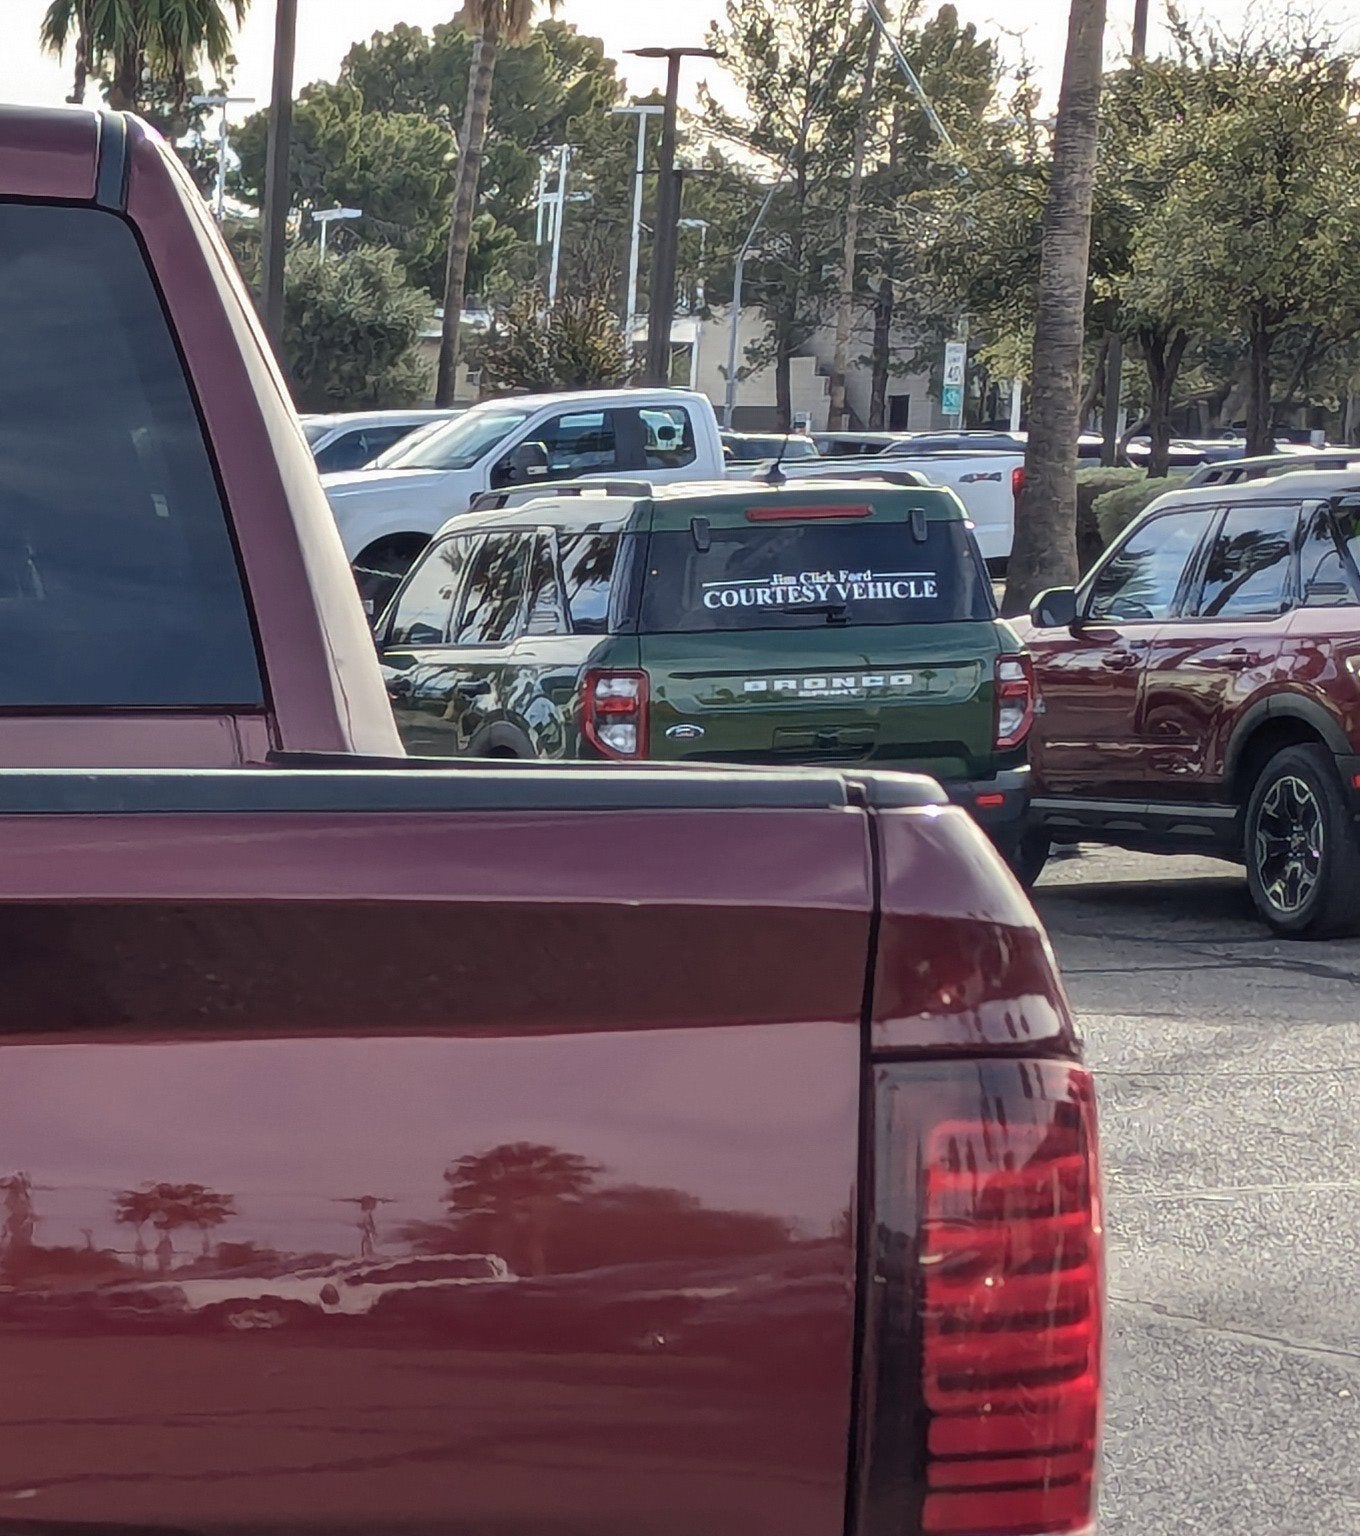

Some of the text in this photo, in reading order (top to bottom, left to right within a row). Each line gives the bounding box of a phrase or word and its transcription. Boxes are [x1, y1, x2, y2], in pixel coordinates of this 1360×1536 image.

[770, 569, 872, 590] Jim Click Ford
[702, 580, 938, 609] COURTESY VEHICLE
[743, 673, 914, 692] BRONCO
